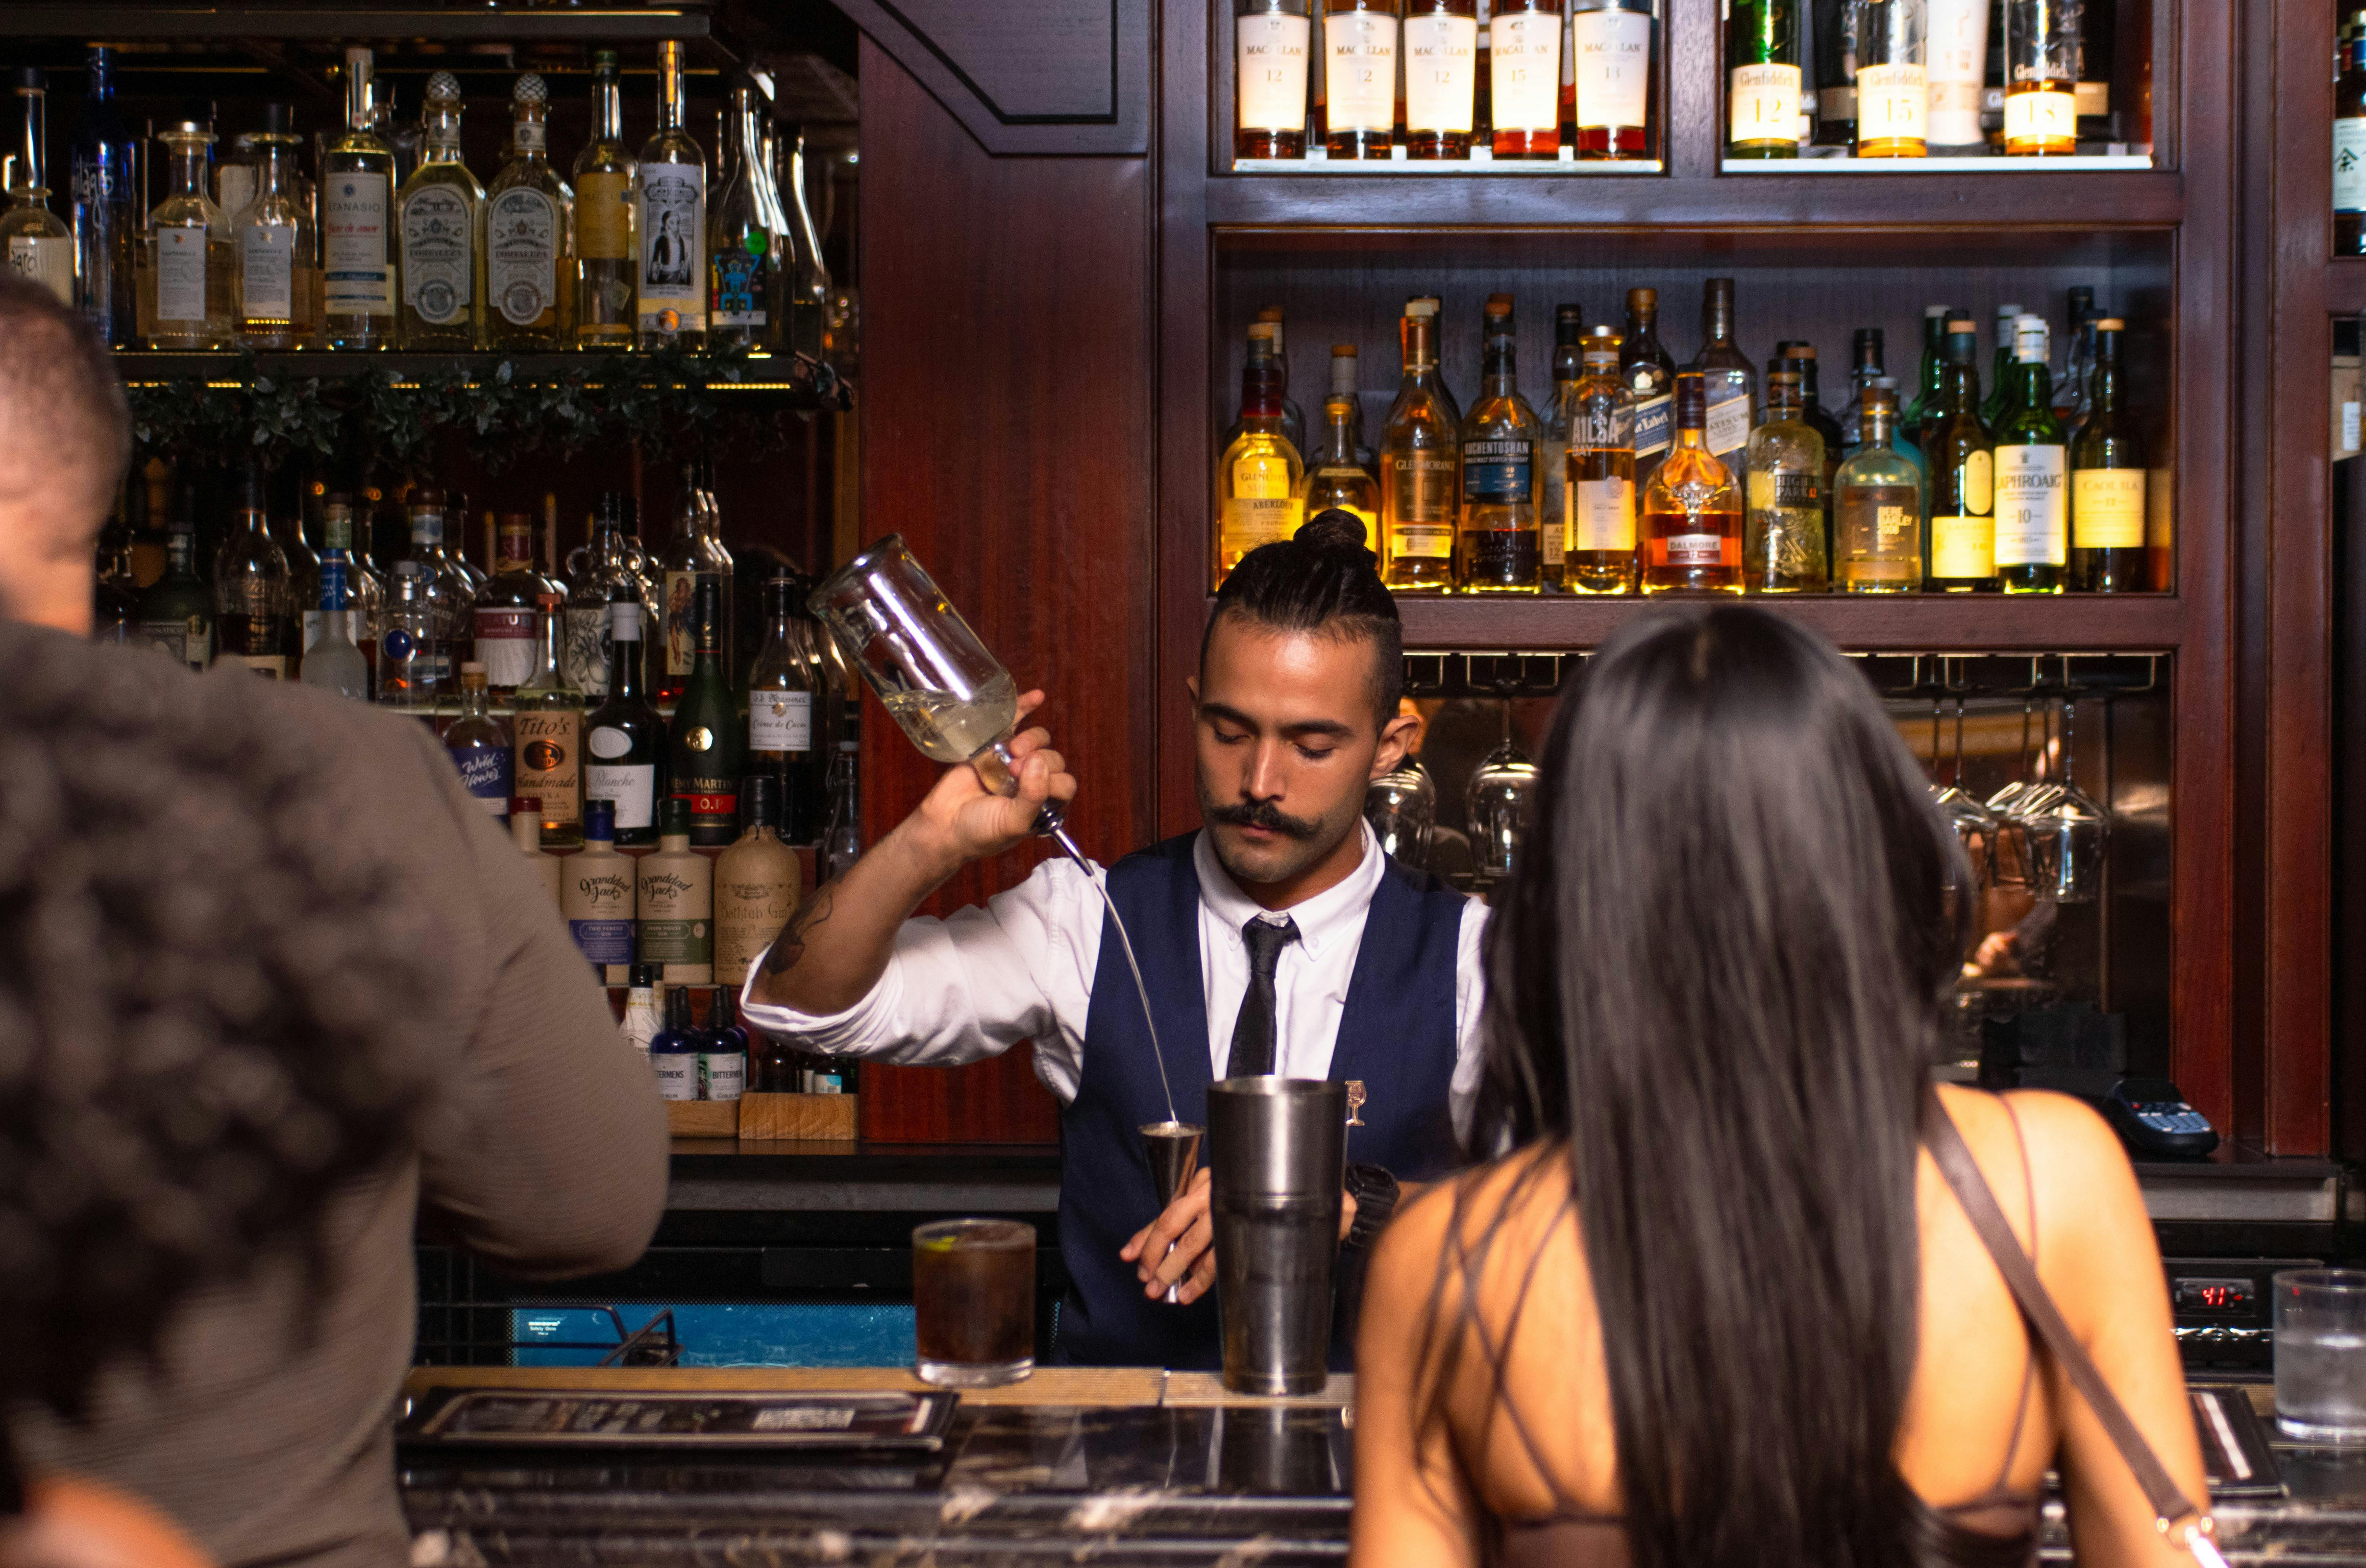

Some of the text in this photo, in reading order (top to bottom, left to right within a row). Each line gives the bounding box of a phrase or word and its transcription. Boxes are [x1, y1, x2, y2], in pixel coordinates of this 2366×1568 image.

[1267, 69, 1282, 82] 12
[1357, 69, 1372, 82] 12
[1435, 70, 1450, 83] 12
[1511, 69, 1526, 81] 15
[2014, 61, 2068, 80] Glenddich
[1755, 98, 1781, 123] 12
[1887, 98, 1912, 122] 15
[1572, 444, 1594, 457] BAY
[2018, 508, 2031, 524] 10
[520, 716, 570, 736] Tito's
[462, 752, 497, 774] Wild
[693, 777, 733, 789] MARTIN
[579, 874, 632, 897] Granddad
[640, 872, 693, 895] Granddad
[719, 901, 788, 921] Bathtub Gin
[2202, 1287, 2225, 1306] 41
